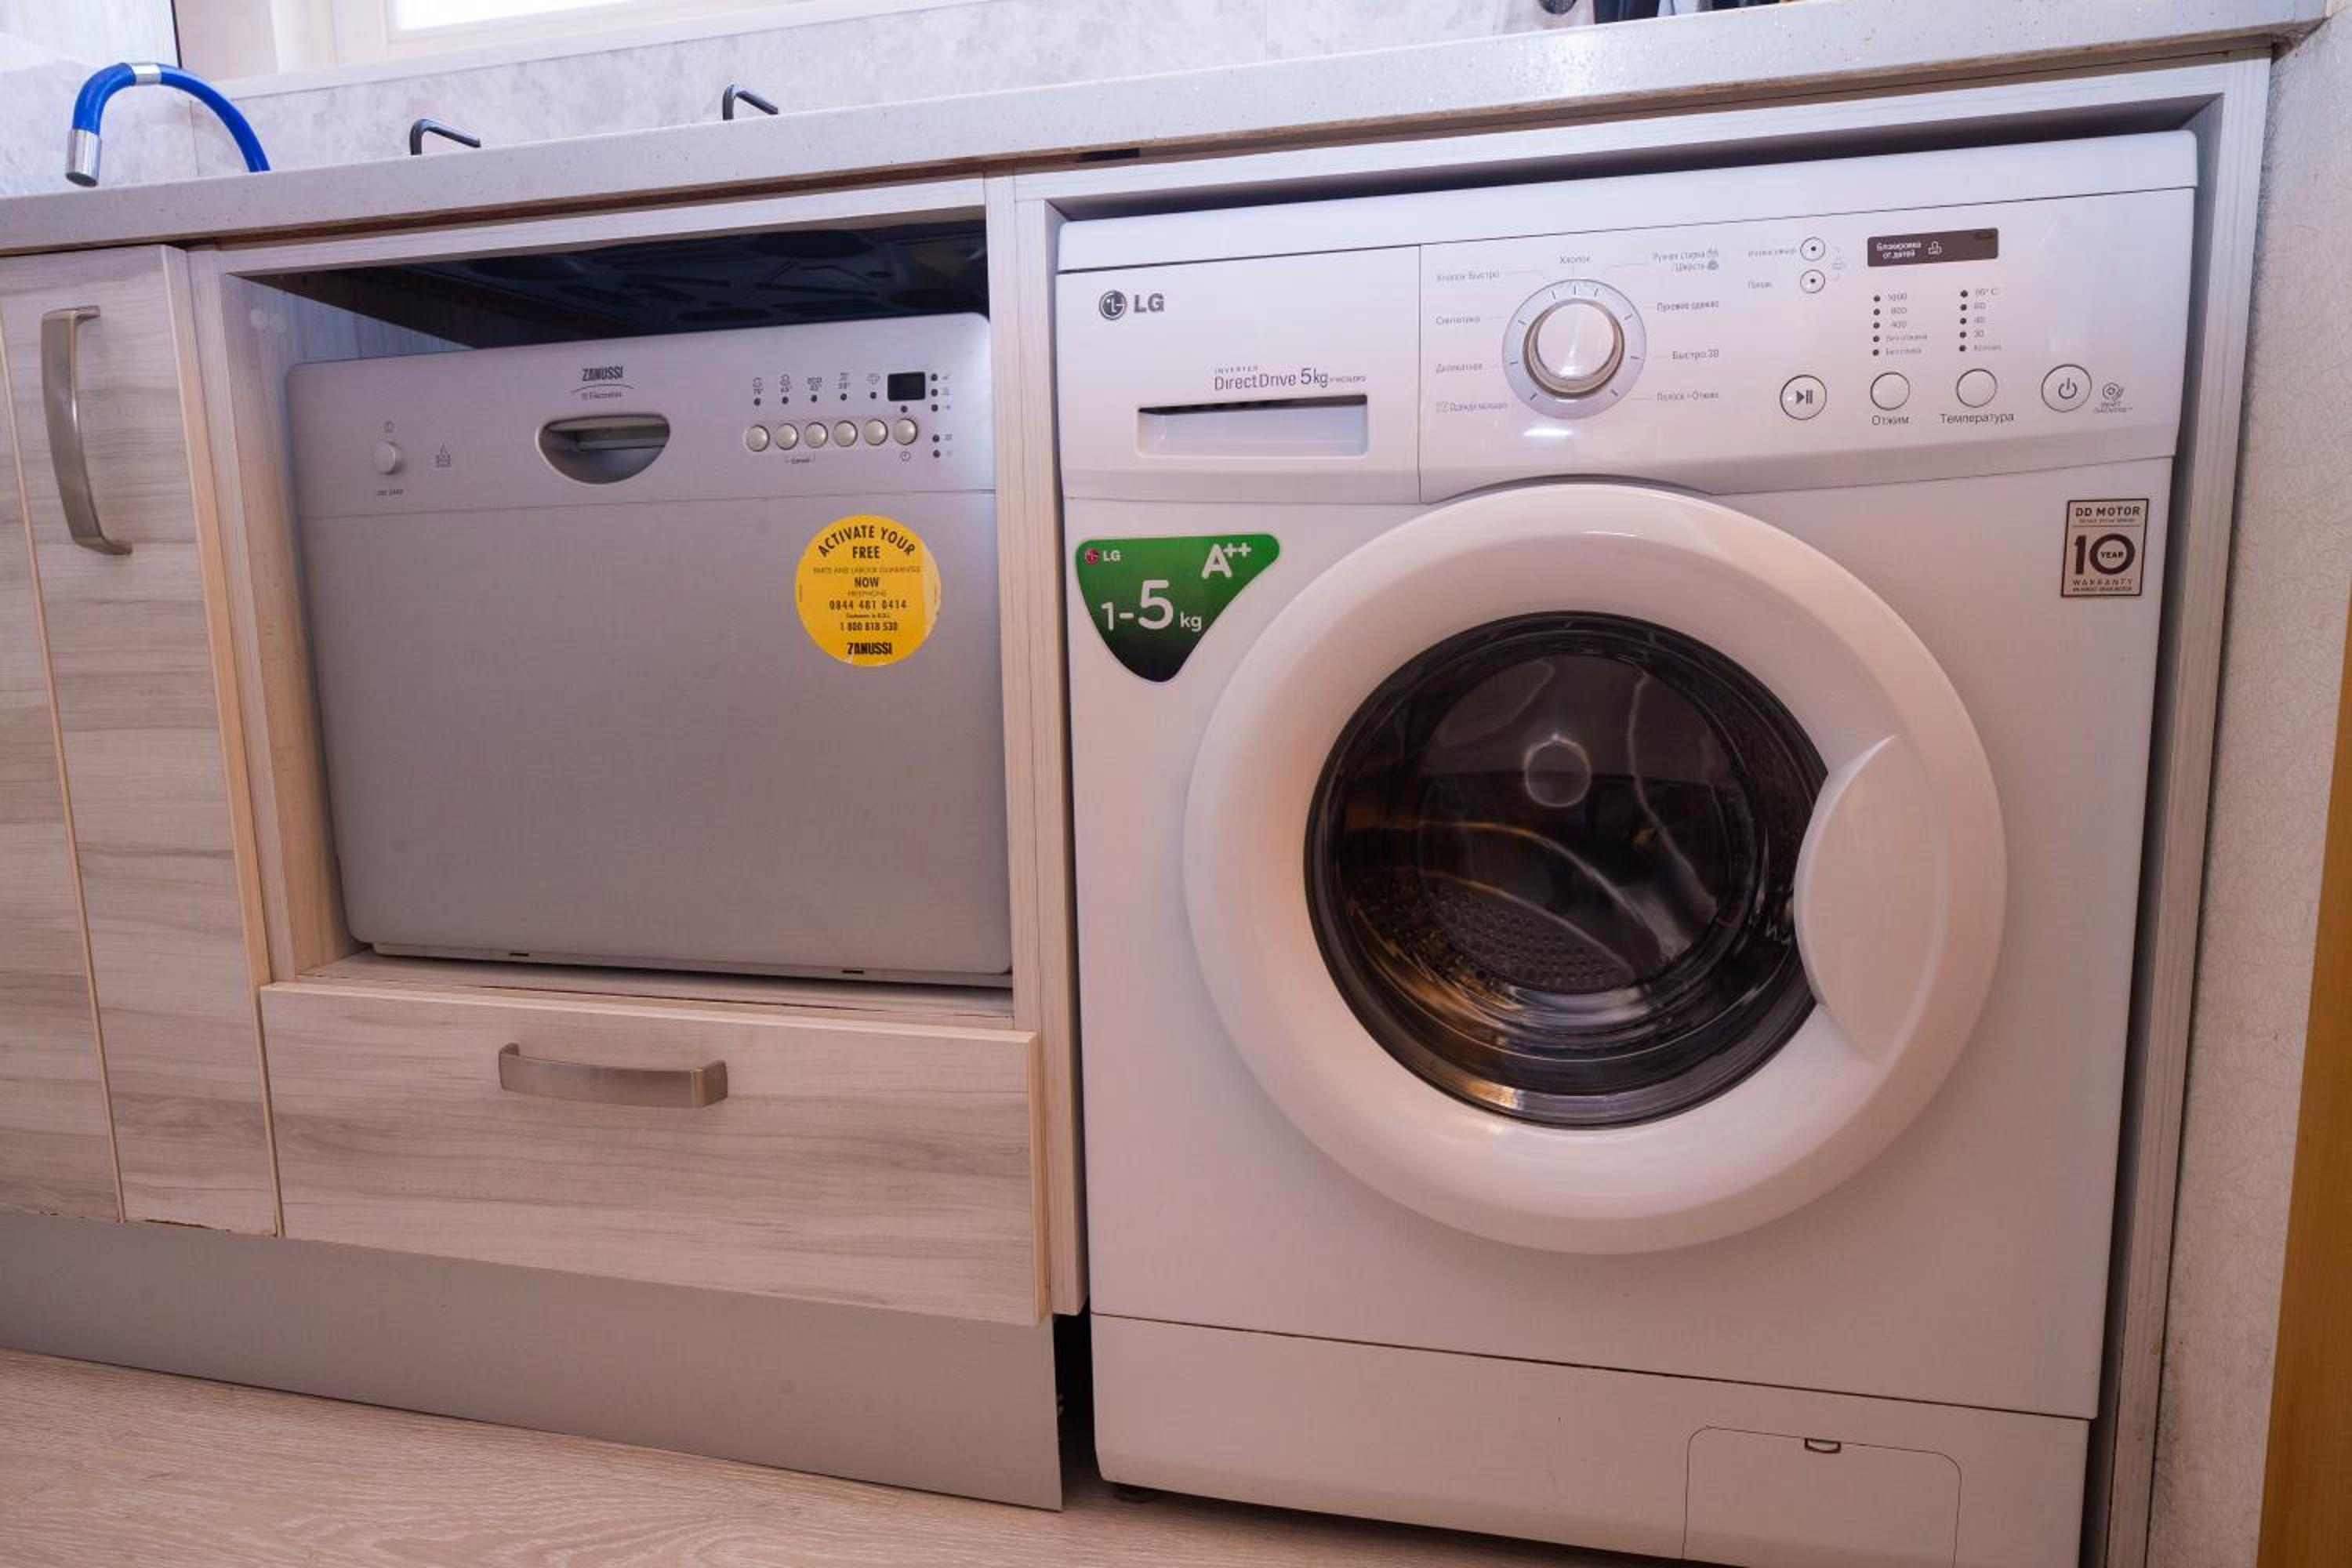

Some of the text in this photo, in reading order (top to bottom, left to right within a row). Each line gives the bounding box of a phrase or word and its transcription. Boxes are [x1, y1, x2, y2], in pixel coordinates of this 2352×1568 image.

[1134, 293, 1164, 313] LG
[582, 365, 623, 382] ZANUSSI
[1871, 414, 1910, 426] Отжим
[1940, 412, 2015, 426] Температура
[2075, 506, 2141, 517] DD MOTOR
[818, 525, 916, 557] ACTIVATE YOUR
[852, 546, 880, 559] FREE
[1103, 551, 1121, 561] LG
[2074, 532, 2136, 575] 10
[1201, 542, 1253, 579] A++
[854, 576, 879, 587] NOW
[2072, 578, 2133, 586] WARRANTY
[1180, 612, 1203, 632] kg
[847, 642, 893, 655] ZANUSSI
